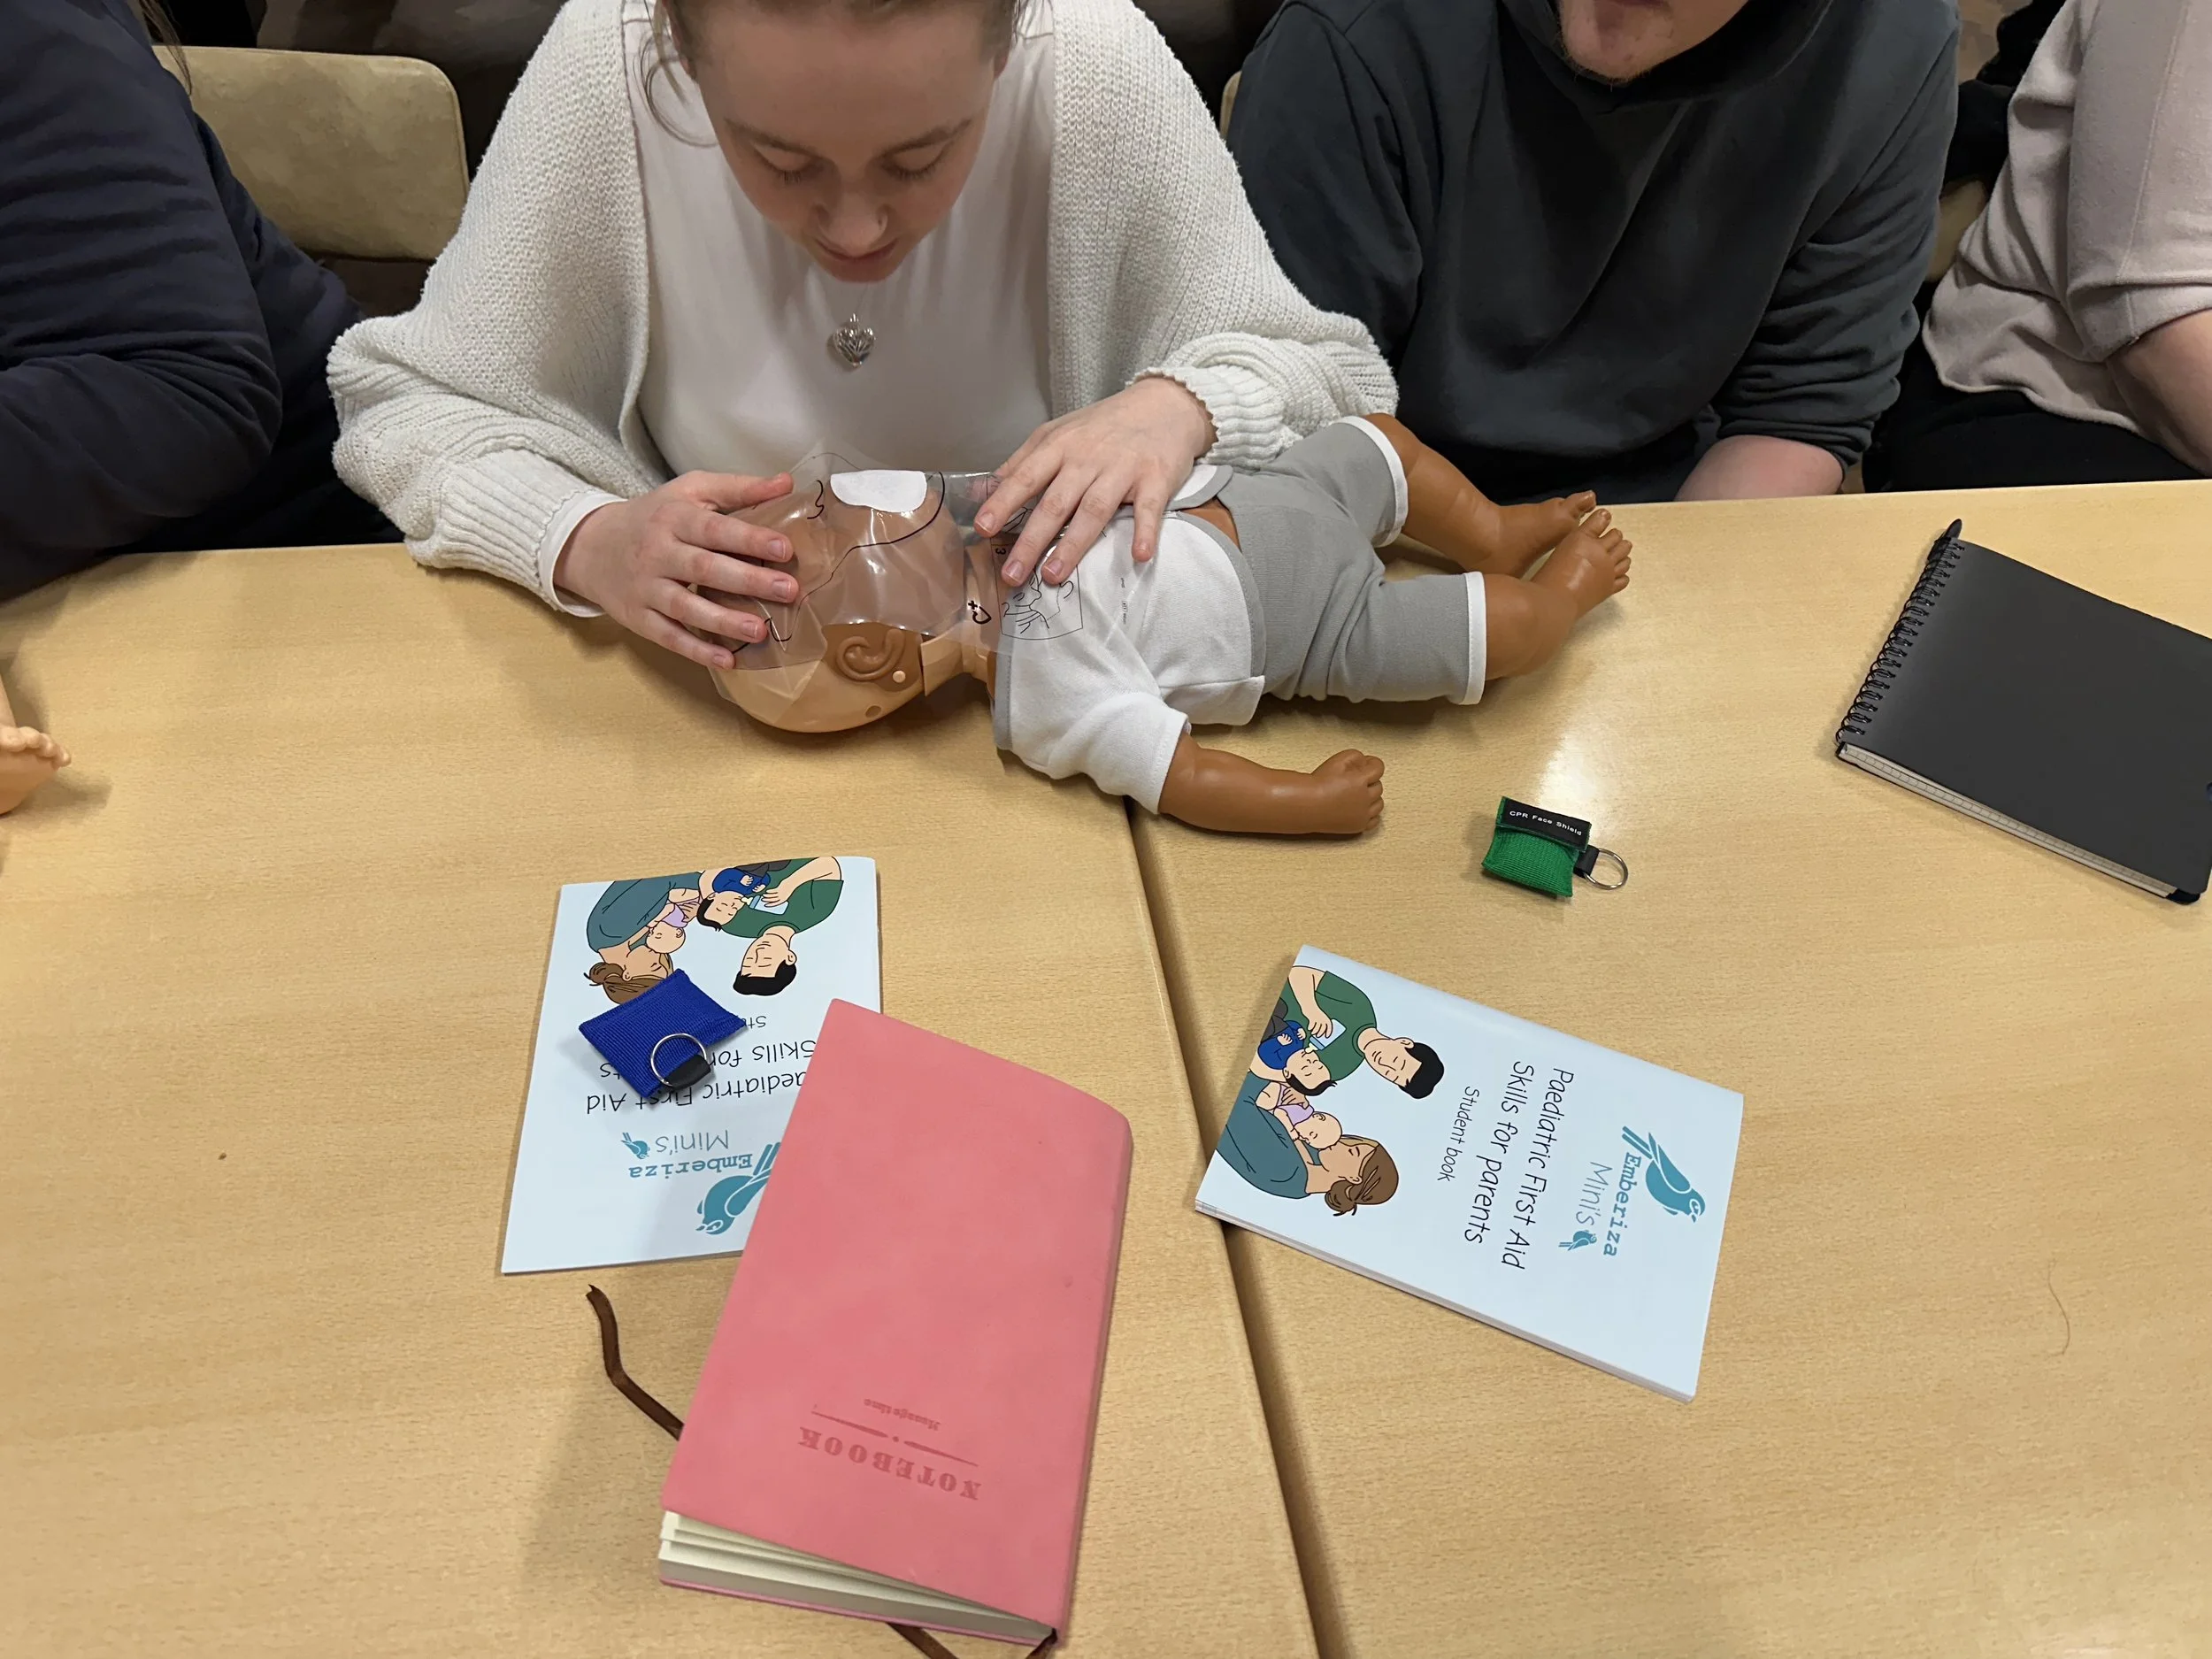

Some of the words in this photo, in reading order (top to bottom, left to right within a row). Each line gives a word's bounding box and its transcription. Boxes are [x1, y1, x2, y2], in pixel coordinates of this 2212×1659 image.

[1532, 814, 1553, 825] Face
[1555, 821, 1582, 836] Shield
[708, 1050, 742, 1068] for
[752, 1040, 816, 1063] Skills
[587, 1093, 627, 1115] Aid
[702, 1071, 808, 1100] aediatric
[1501, 1061, 1535, 1115] Skills
[1449, 1087, 1480, 1145] Student
[1527, 1067, 1575, 1170] Paediatric
[656, 1129, 729, 1156] Mini's
[1491, 1121, 1518, 1155] for
[628, 1154, 753, 1179] Emberiza
[1437, 1147, 1463, 1182] book
[1464, 1155, 1502, 1244] parents
[1513, 1173, 1548, 1226] First
[1576, 1161, 1613, 1226] Mini's
[1603, 1151, 1642, 1256] Emberiza
[1502, 1229, 1531, 1271] Aid
[797, 1426, 982, 1501] NOTEBOOK
